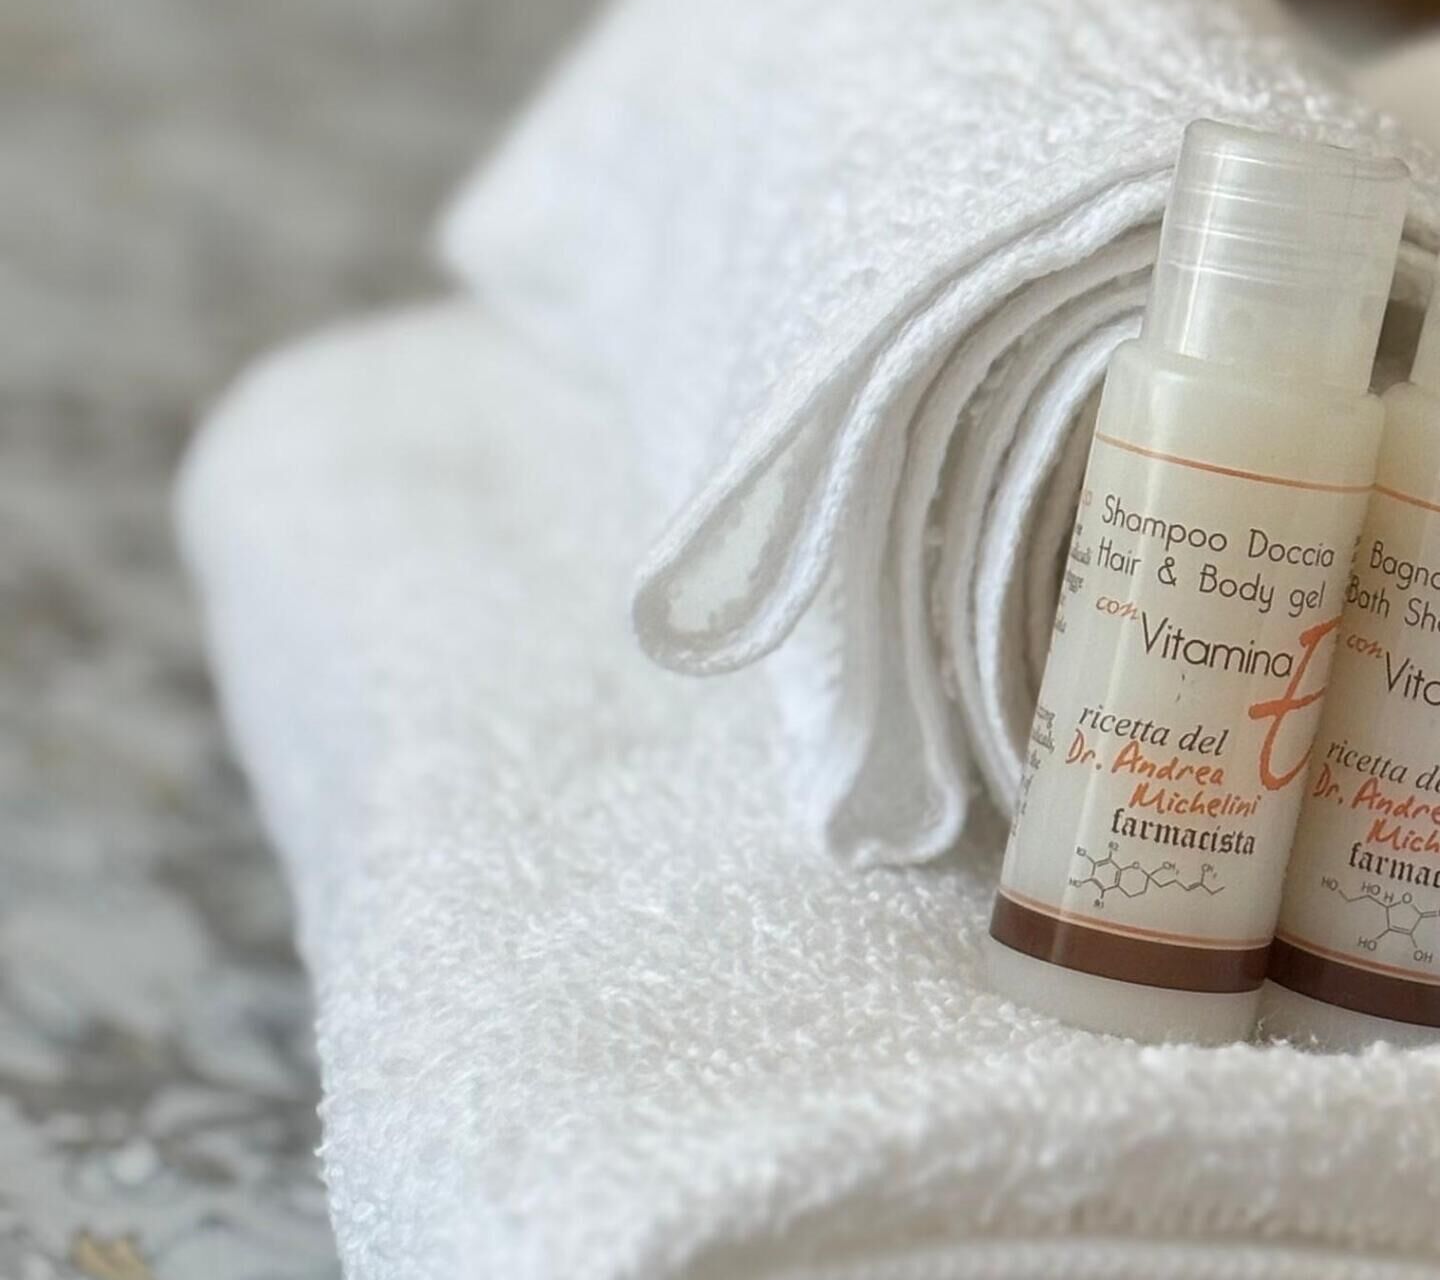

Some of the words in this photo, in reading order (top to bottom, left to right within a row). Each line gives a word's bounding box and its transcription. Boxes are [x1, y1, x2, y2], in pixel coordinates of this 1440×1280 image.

[1101, 494, 1228, 552] Shampoo
[1248, 529, 1335, 567] Doccia
[1097, 536, 1142, 576] Hair
[1157, 556, 1177, 587] &
[1200, 564, 1274, 614] Body
[1288, 581, 1326, 618] gel
[1346, 574, 1390, 618] Bath
[1096, 596, 1139, 620] con
[1142, 611, 1294, 678] Vitamina
[1346, 632, 1384, 659] con
[1079, 704, 1171, 747] ricetta
[1179, 725, 1230, 757] del
[1065, 728, 1102, 770] Dr.
[1111, 740, 1224, 787] Andrea
[1326, 740, 1410, 783] ricetta
[1129, 783, 1262, 818] Michelini
[1312, 763, 1344, 805] Dr.
[1111, 808, 1256, 856] farmacista
[1321, 876, 1338, 892] HO
[1361, 882, 1381, 896] HO
[1358, 936, 1377, 952] HO
[1413, 950, 1433, 963] OH
